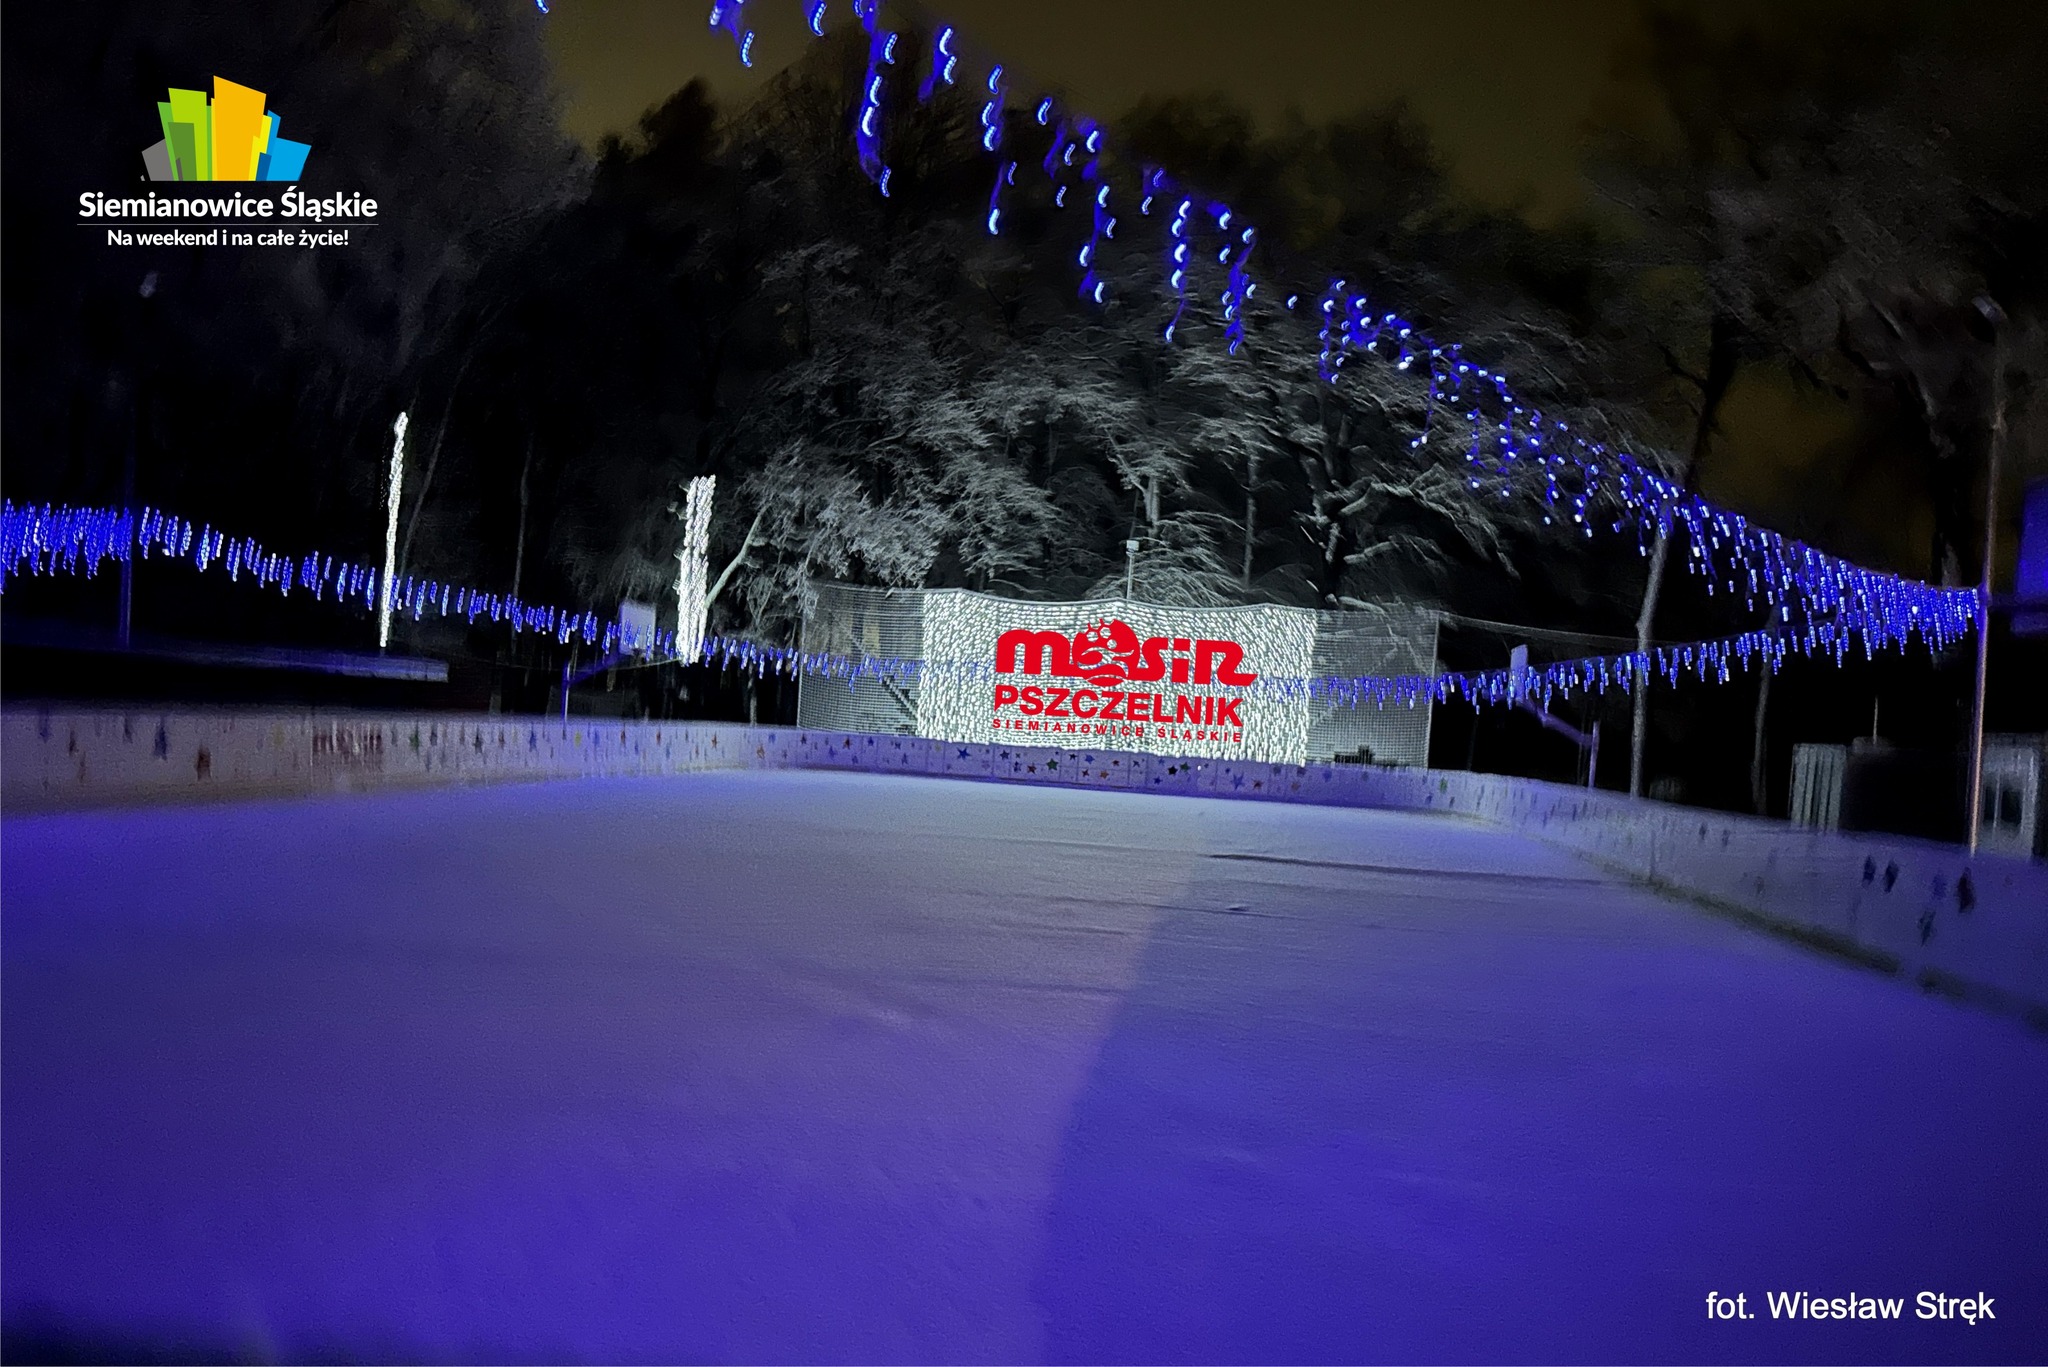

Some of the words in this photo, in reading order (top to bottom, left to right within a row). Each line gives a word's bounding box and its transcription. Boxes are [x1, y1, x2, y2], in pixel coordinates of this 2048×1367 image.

[993, 684, 1244, 728] PSZCZELNIK
[992, 718, 1145, 737] SIEMIANOWICE
[1157, 726, 1242, 743] ŚLĄSKIE
